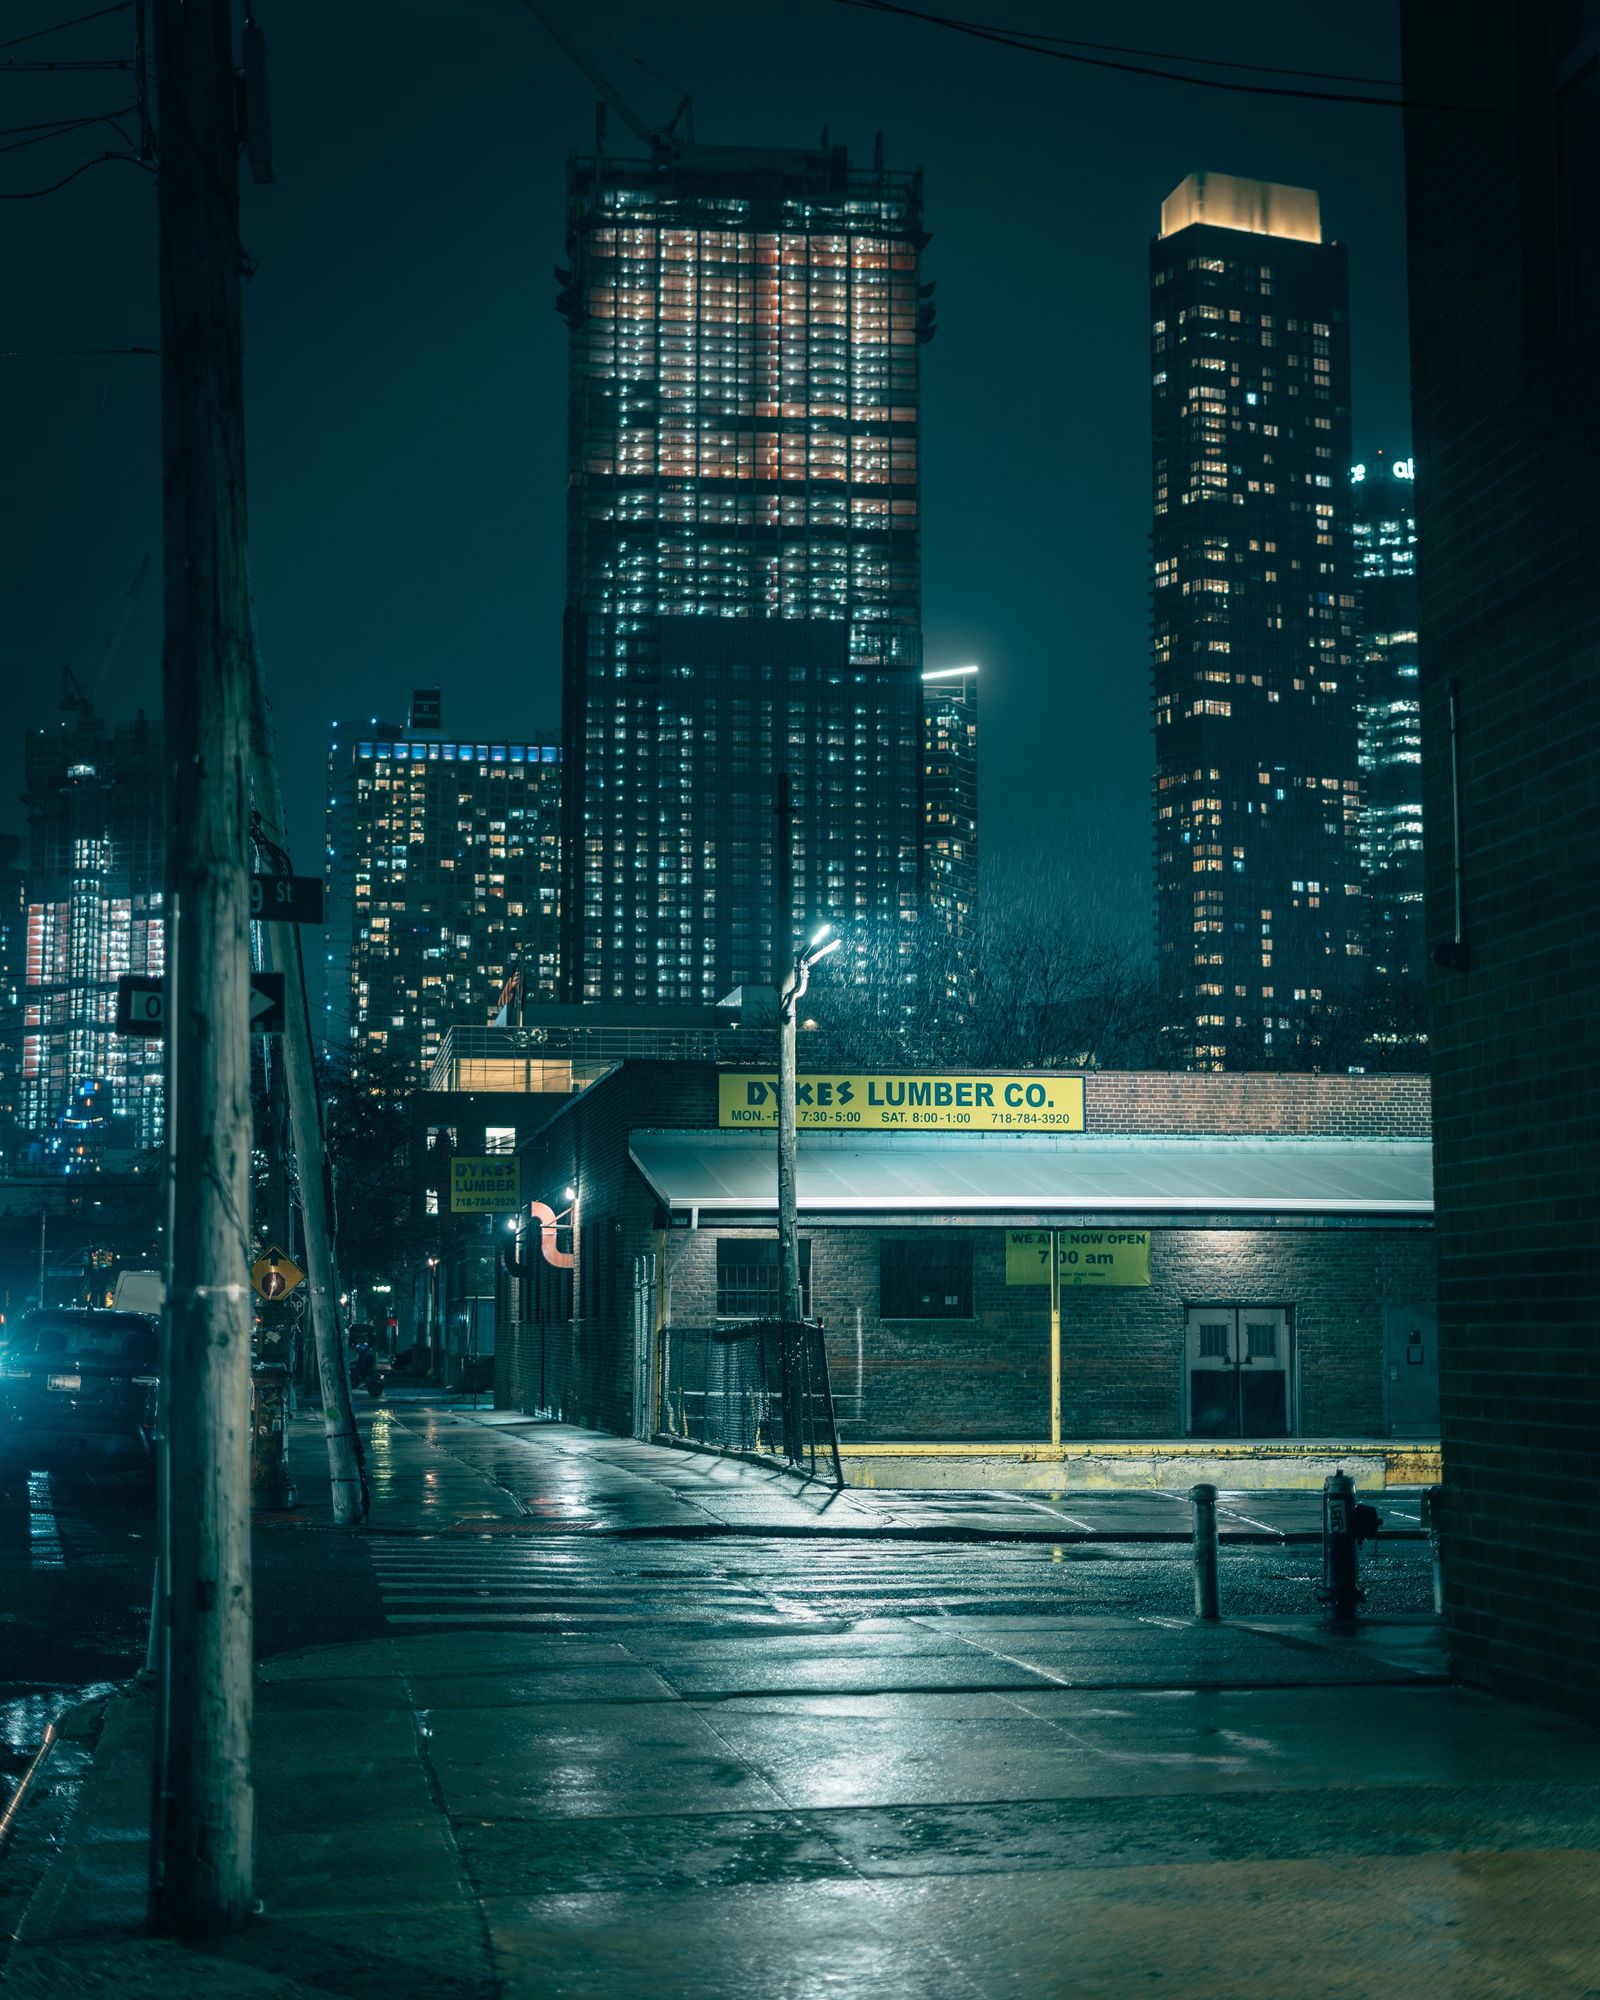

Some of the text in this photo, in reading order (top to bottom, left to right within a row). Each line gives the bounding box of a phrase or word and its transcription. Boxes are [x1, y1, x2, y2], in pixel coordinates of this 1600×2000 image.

[276, 881, 292, 903] St
[868, 1082, 995, 1107] LUMBER
[1004, 1083, 1054, 1108] CO.
[881, 1112, 907, 1123] SAT.
[991, 1113, 1070, 1124] 718-784-3920
[455, 1162, 516, 1177] DYKES
[455, 1179, 516, 1192] LUMBER
[455, 1197, 517, 1207] 718-784-3920
[1012, 1234, 1033, 1244] WE
[1070, 1234, 1103, 1244] NOW
[1107, 1234, 1146, 1244] OPEN
[1085, 1253, 1114, 1264] am
